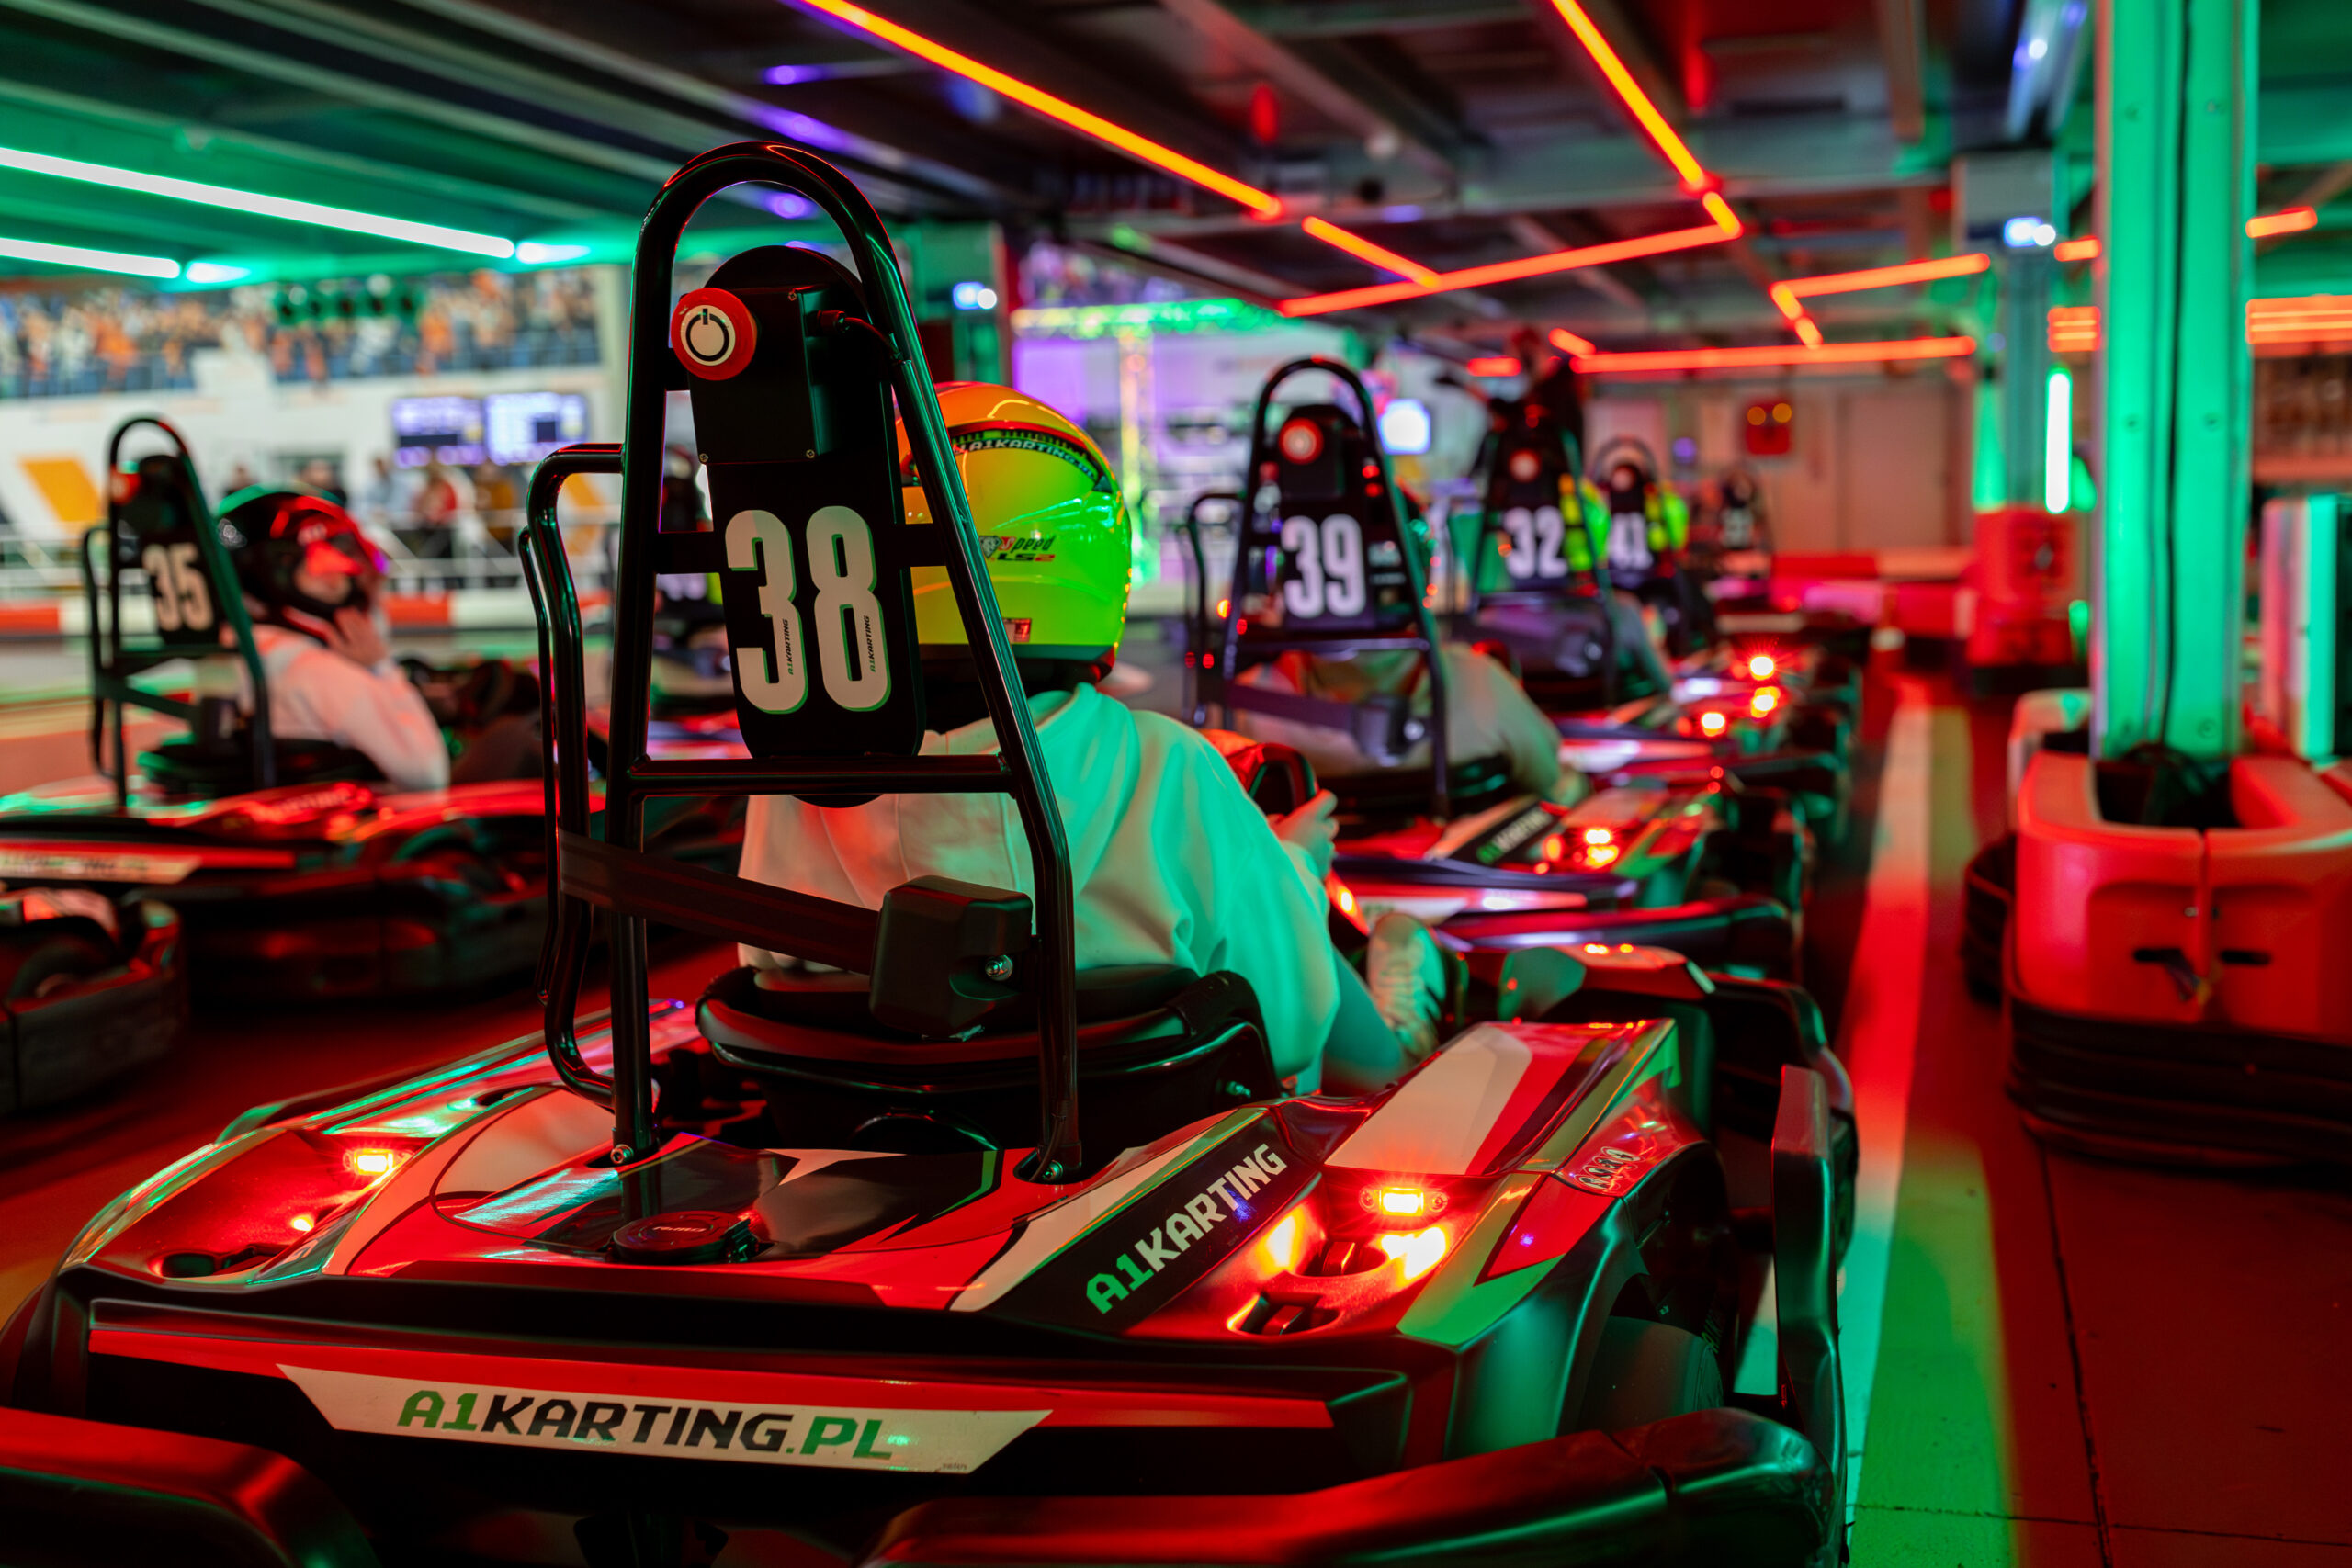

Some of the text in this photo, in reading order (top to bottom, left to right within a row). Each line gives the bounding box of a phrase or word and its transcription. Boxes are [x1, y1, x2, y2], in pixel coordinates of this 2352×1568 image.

[997, 553, 1056, 561] LS2
[1281, 513, 1367, 618] 39
[1503, 505, 1569, 579] 32
[141, 541, 213, 632] 35
[724, 505, 892, 715] 38
[782, 618, 794, 675] A1KARTING
[863, 615, 876, 672] A1KARTING
[1086, 1143, 1288, 1314] A1KARTING
[397, 1389, 894, 1461] A1KARTING.PL
